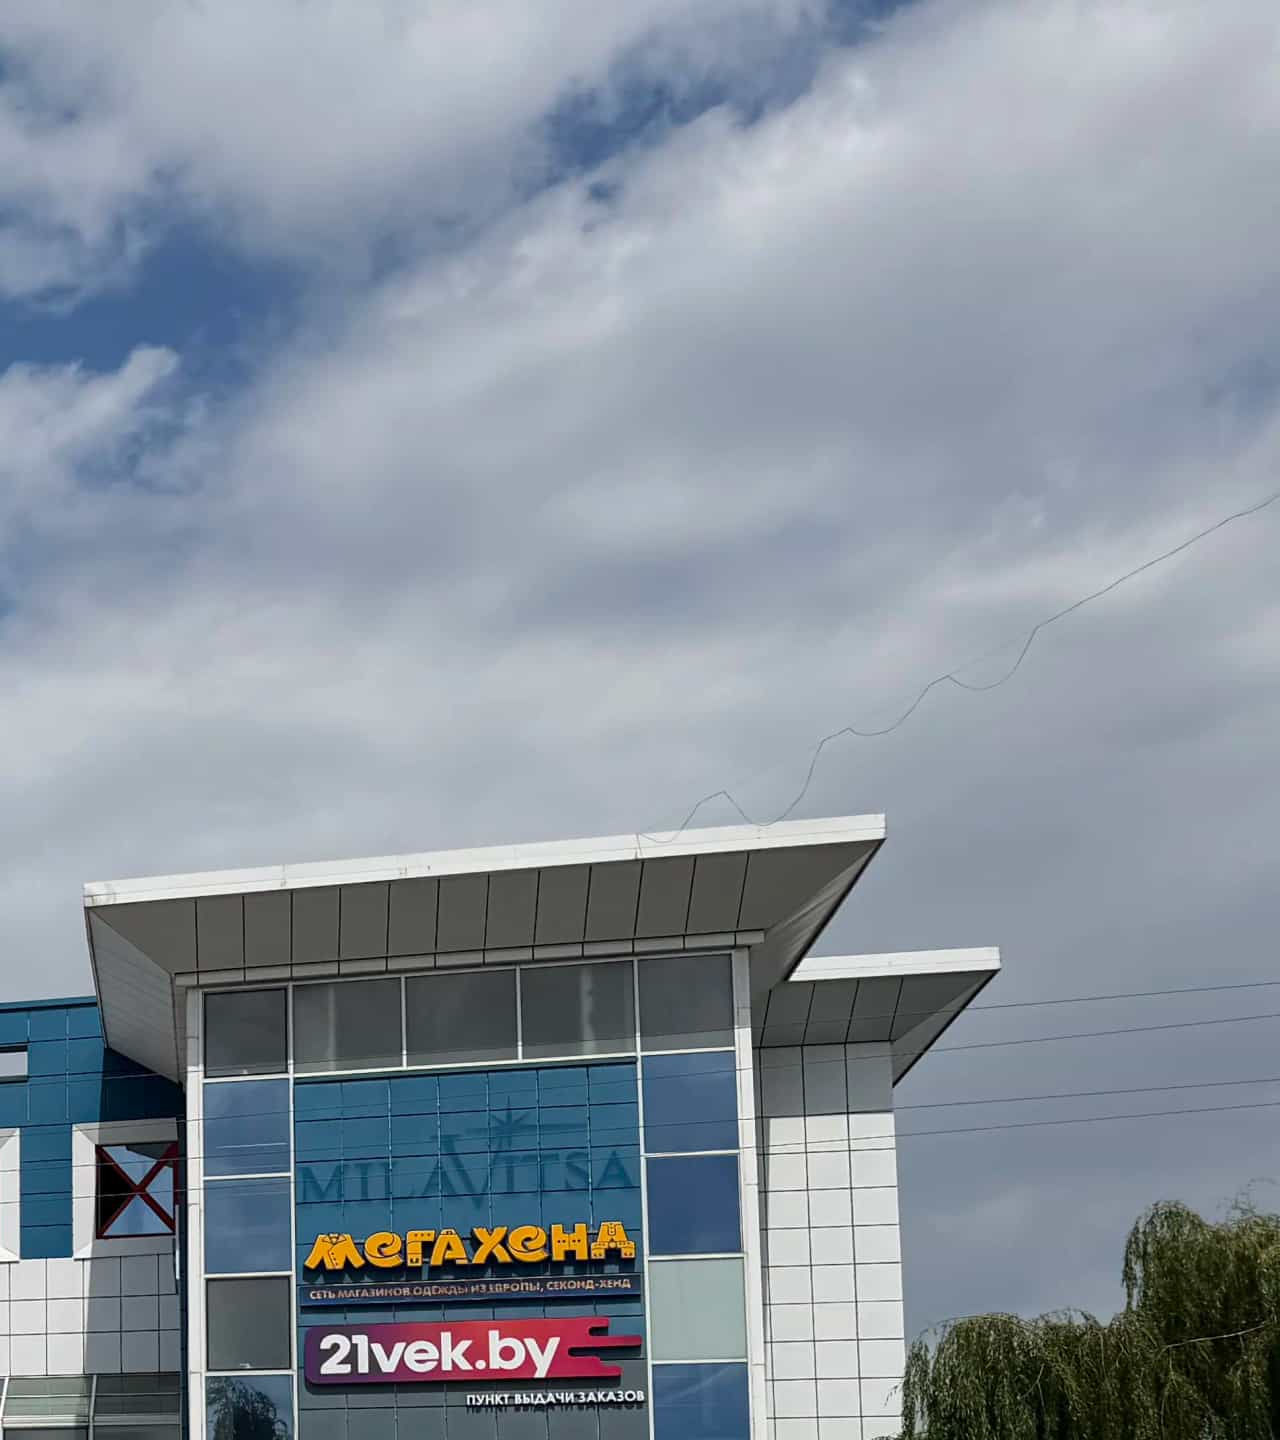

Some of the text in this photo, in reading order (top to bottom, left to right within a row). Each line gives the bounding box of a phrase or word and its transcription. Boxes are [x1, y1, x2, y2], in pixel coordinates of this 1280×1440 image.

[309, 1290, 336, 1300] СЕТЬ
[319, 1329, 561, 1379] 21vek.by
[466, 1390, 646, 1406] ПУНКТ ВЫДАЧИ ЗАКАЗОВ
